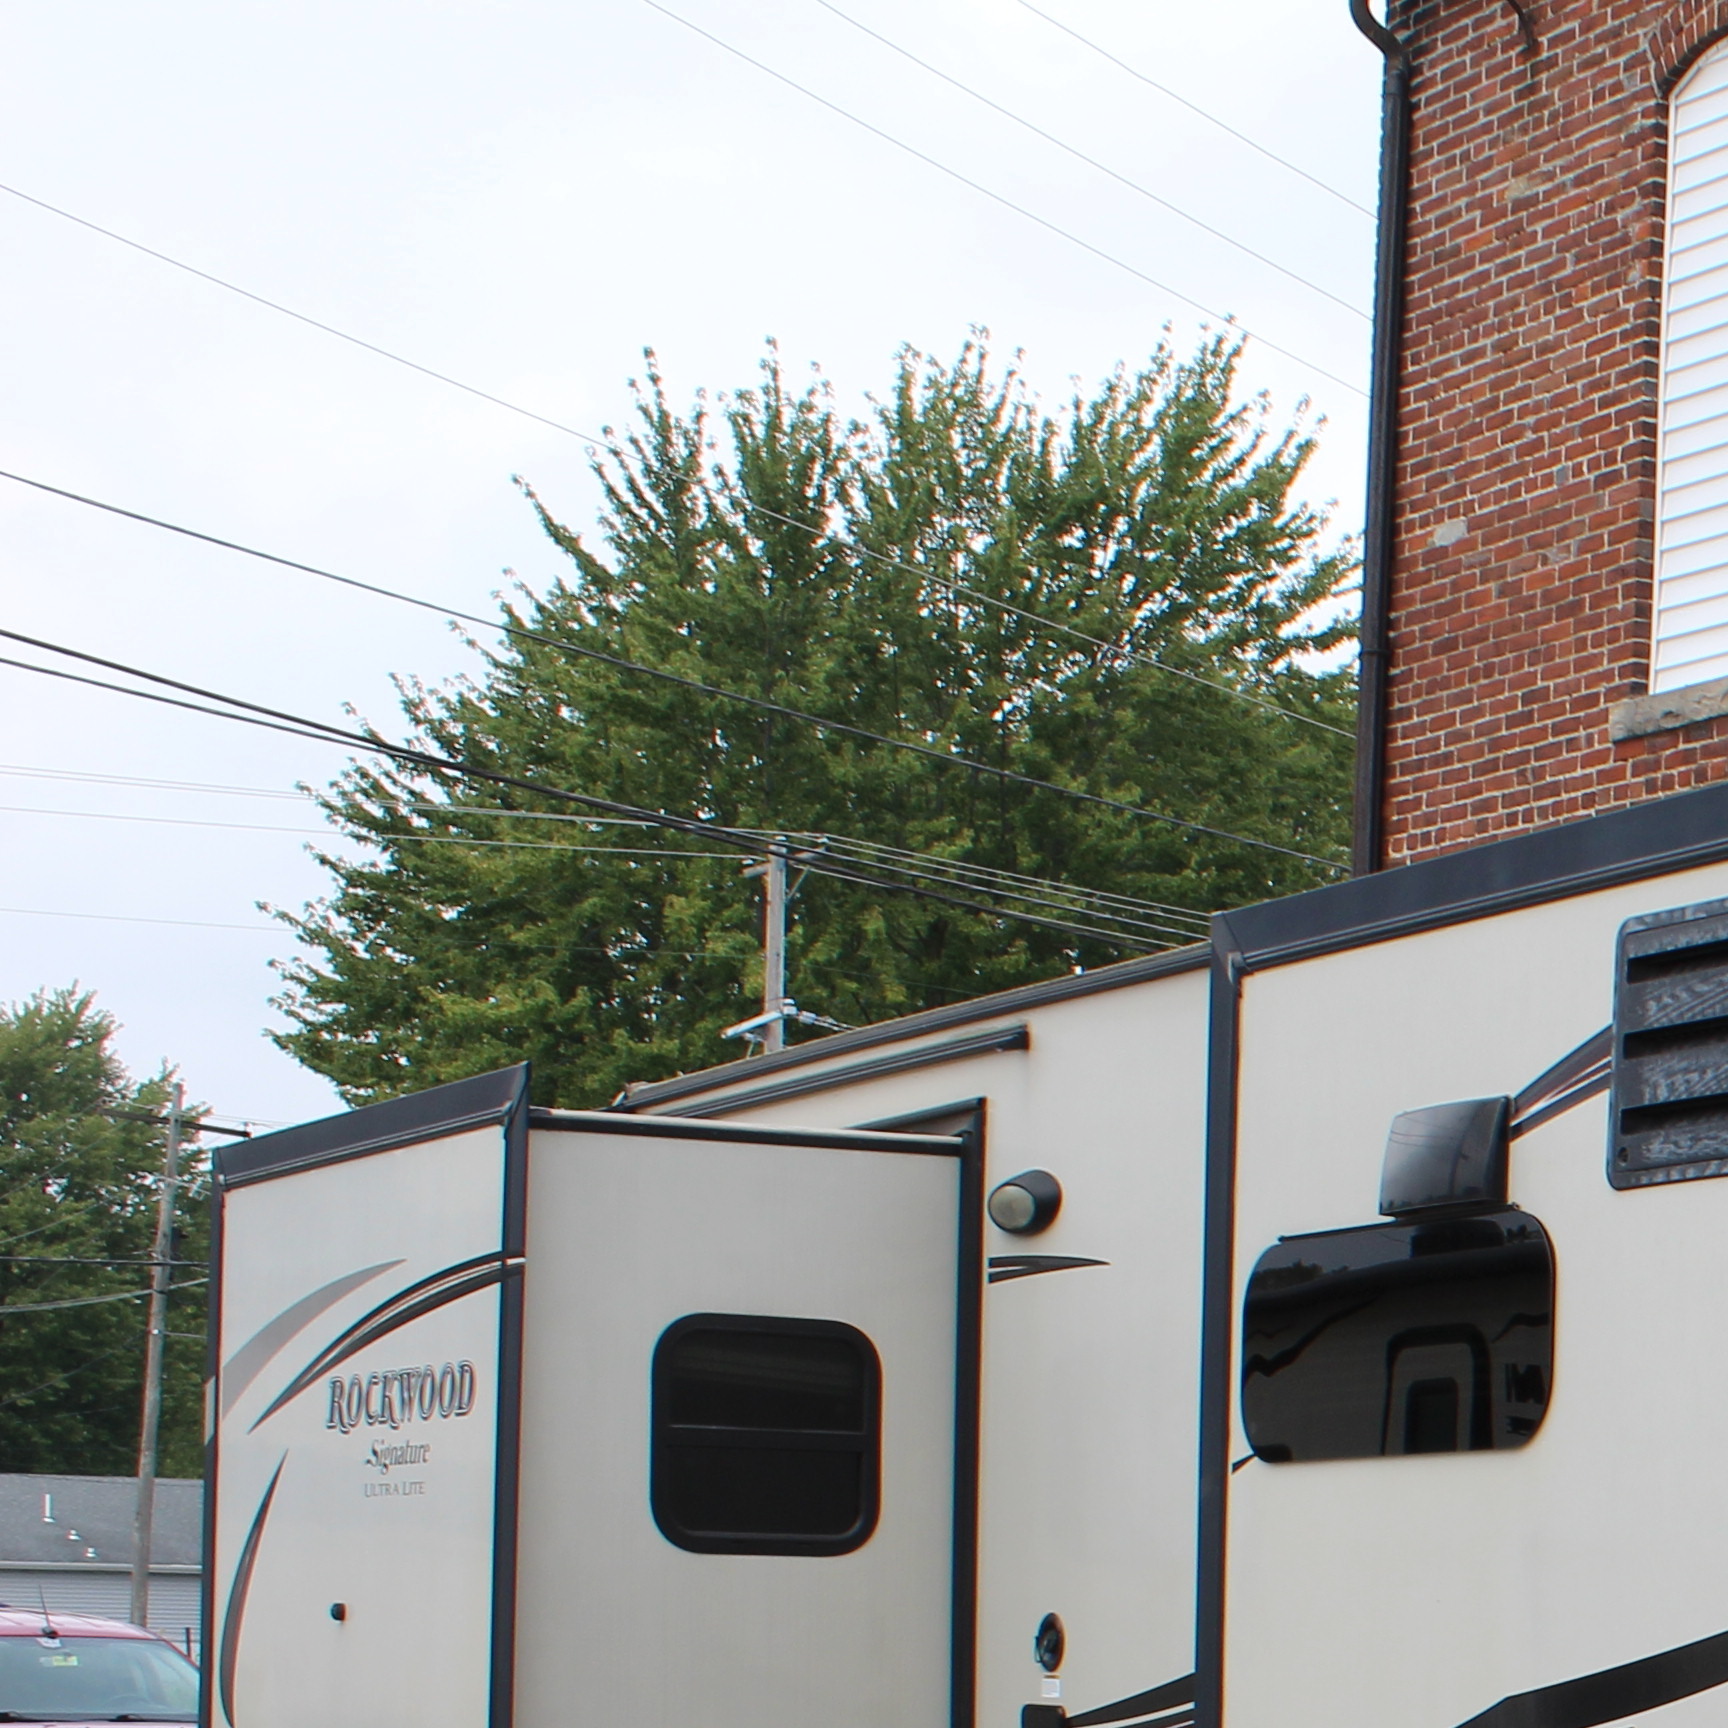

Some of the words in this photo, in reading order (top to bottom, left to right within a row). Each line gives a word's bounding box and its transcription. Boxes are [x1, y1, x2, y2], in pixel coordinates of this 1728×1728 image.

[326, 1360, 478, 1434] ROCKWOOD
[364, 1439, 431, 1475] Signature
[364, 1482, 399, 1498] ULTRA
[402, 1481, 425, 1496] LITE
